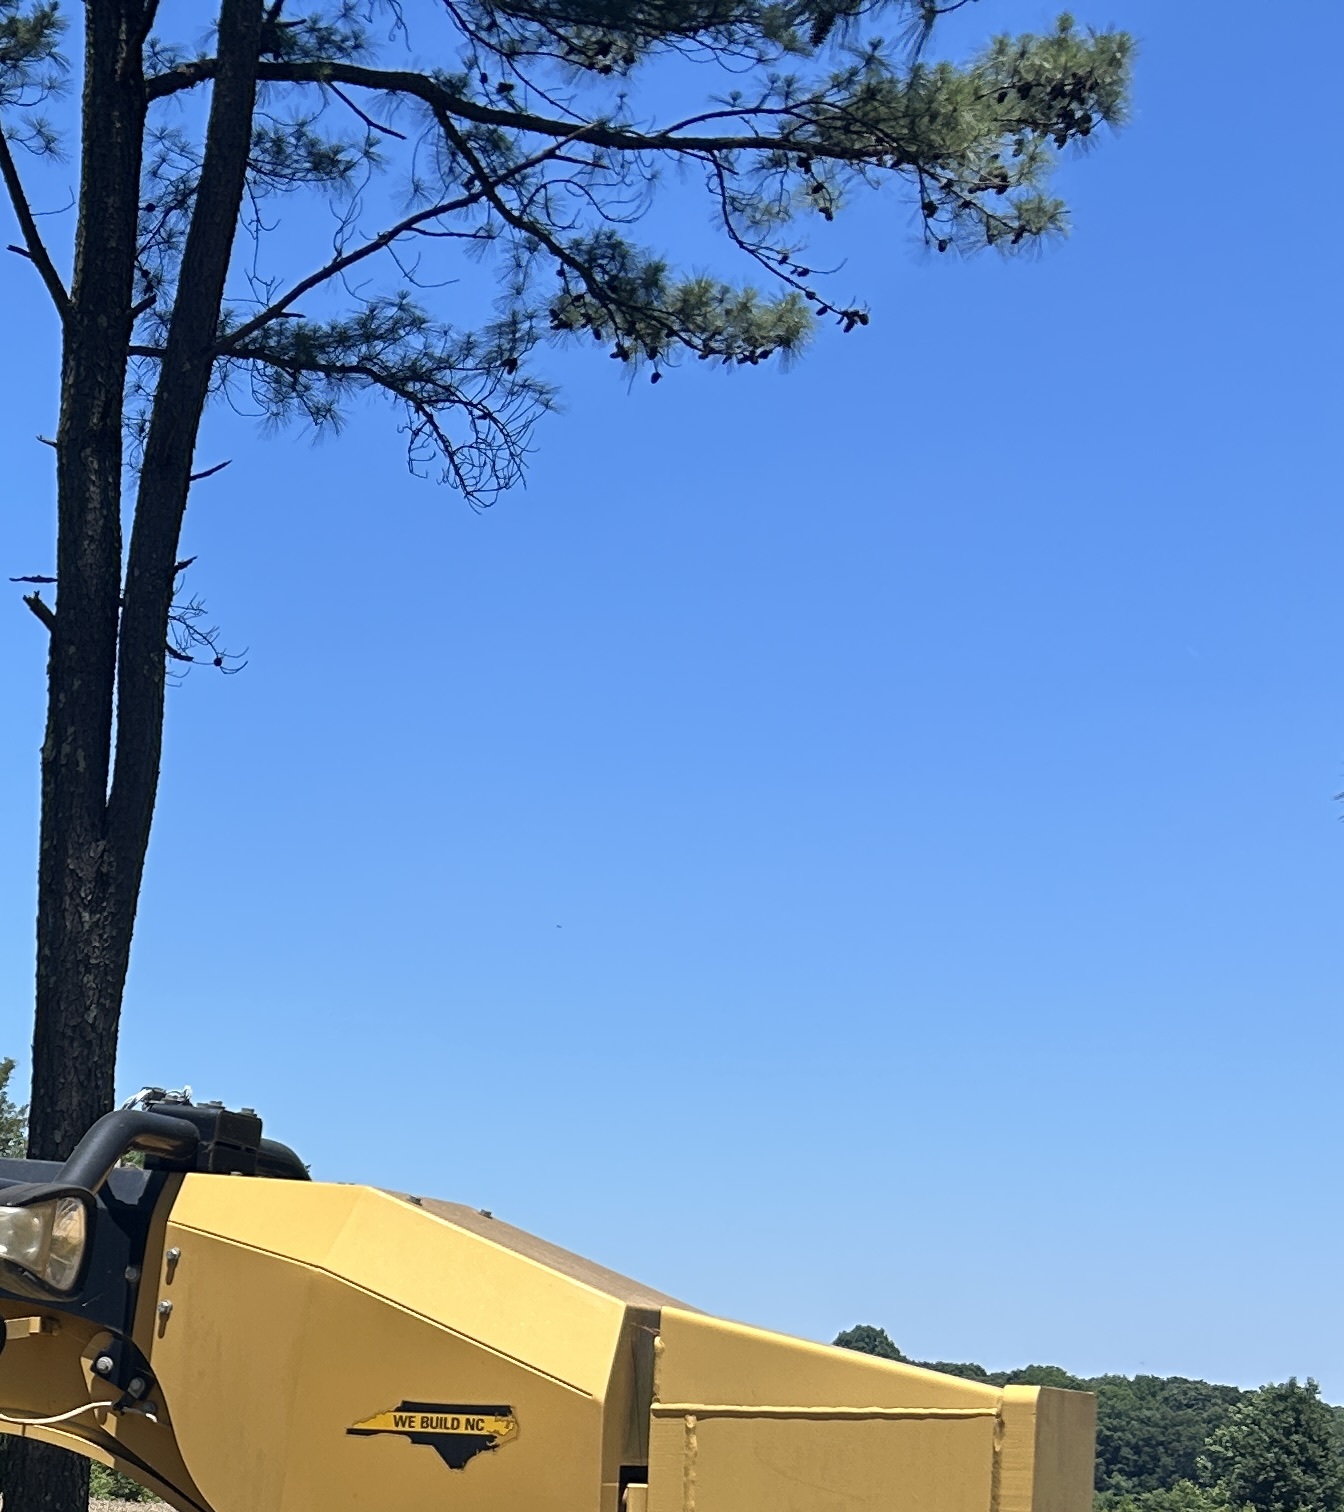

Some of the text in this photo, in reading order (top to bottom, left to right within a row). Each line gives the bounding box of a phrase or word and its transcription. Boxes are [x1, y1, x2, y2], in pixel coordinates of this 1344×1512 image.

[393, 1415, 485, 1432] WE BUILD NC
